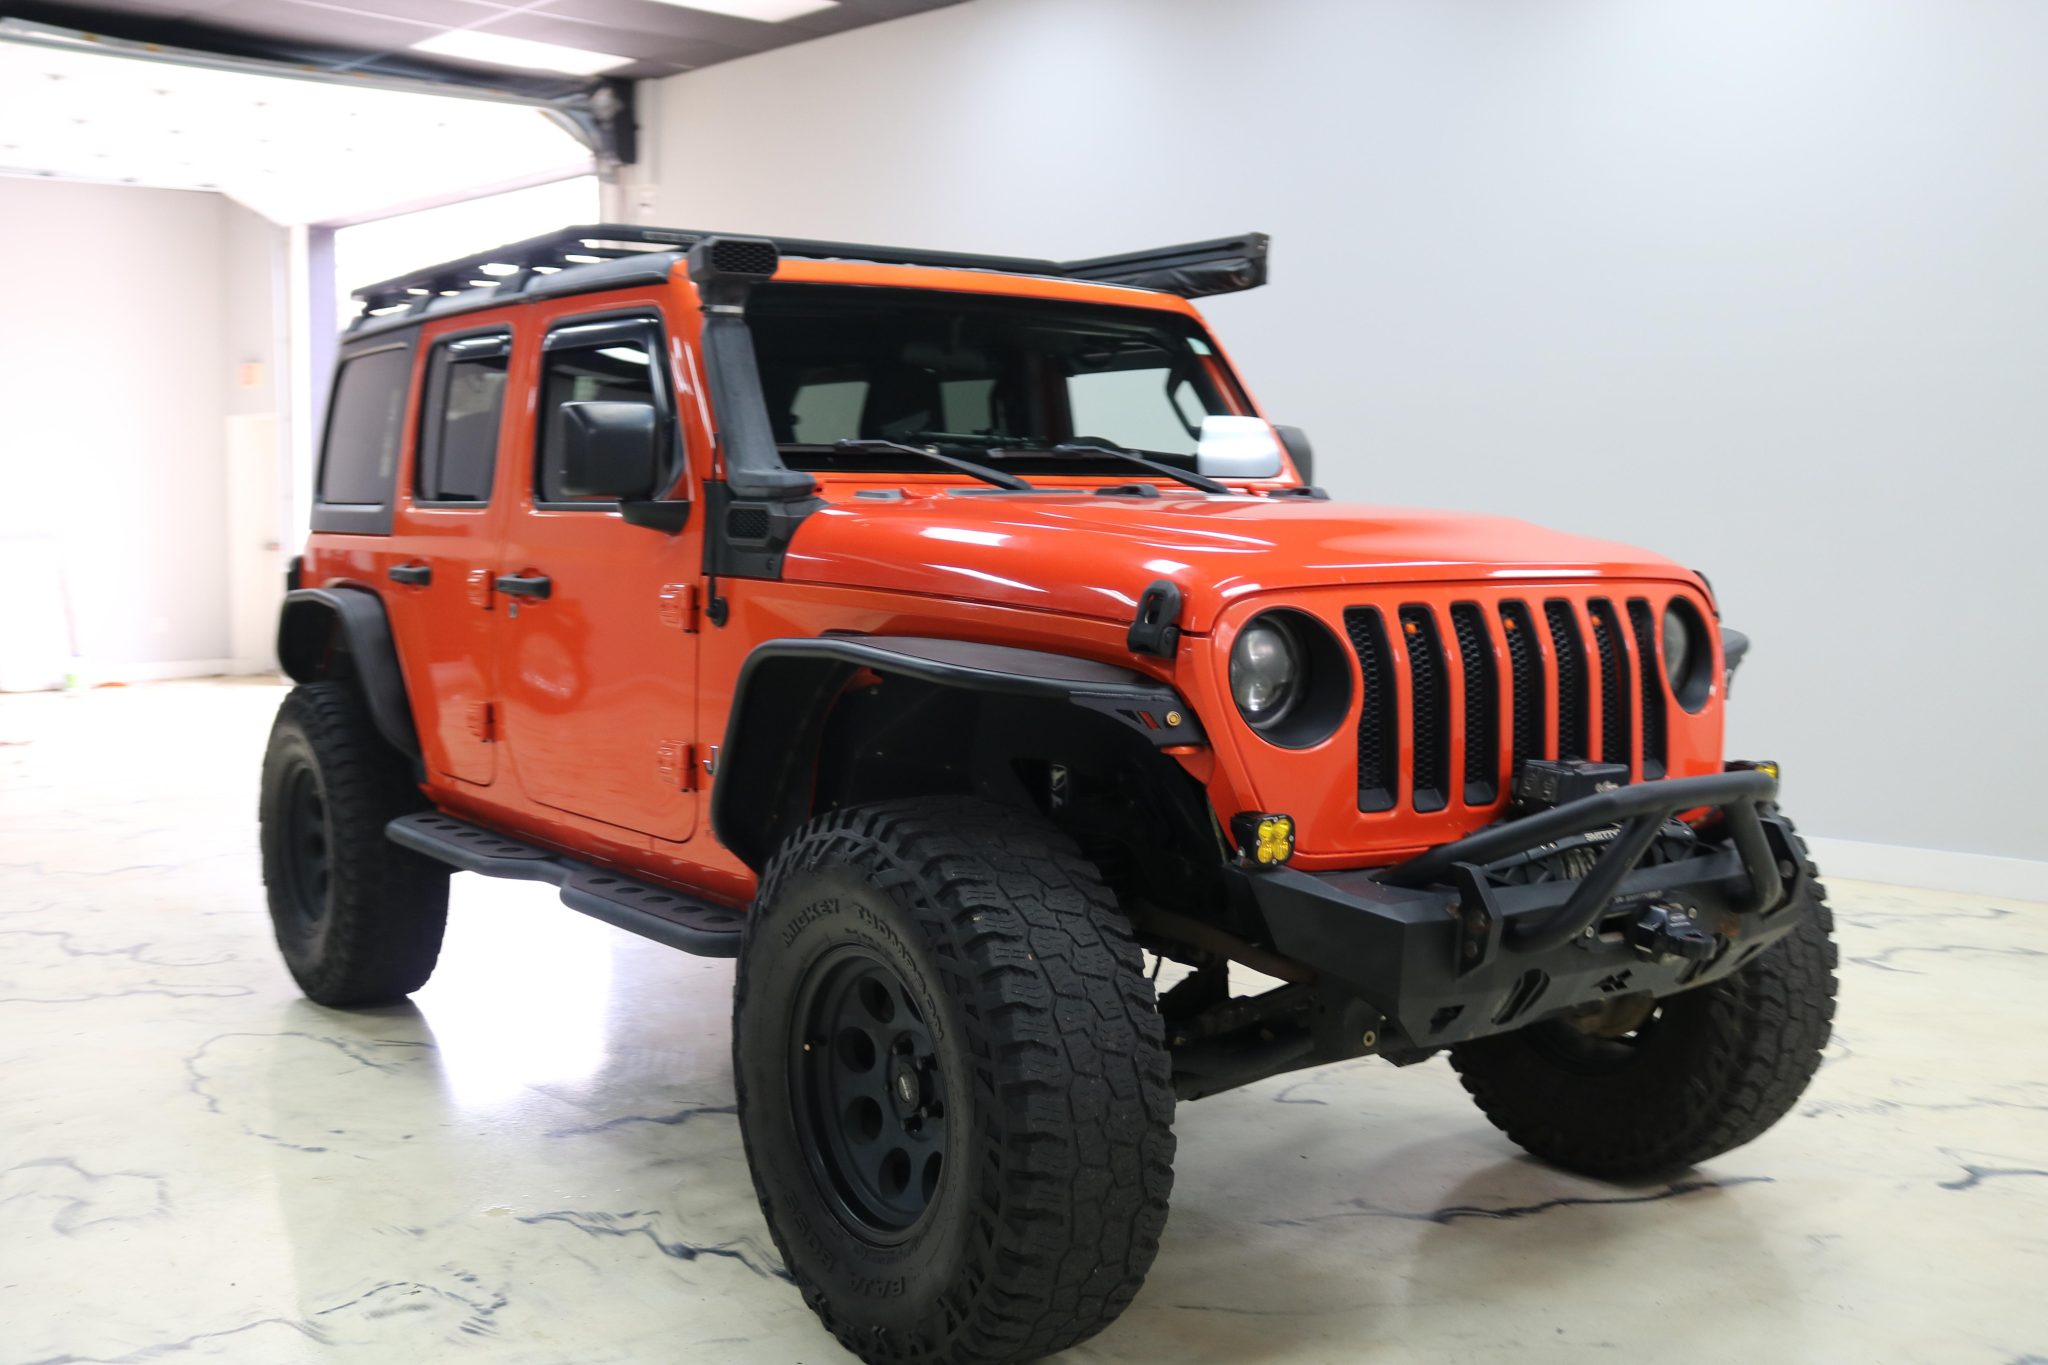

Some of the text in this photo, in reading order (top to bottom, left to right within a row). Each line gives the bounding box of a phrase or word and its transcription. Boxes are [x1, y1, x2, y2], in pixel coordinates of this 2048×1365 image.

[782, 897, 945, 1041] MICKEY THOMPSON
[848, 1273, 906, 1299] BAJA
